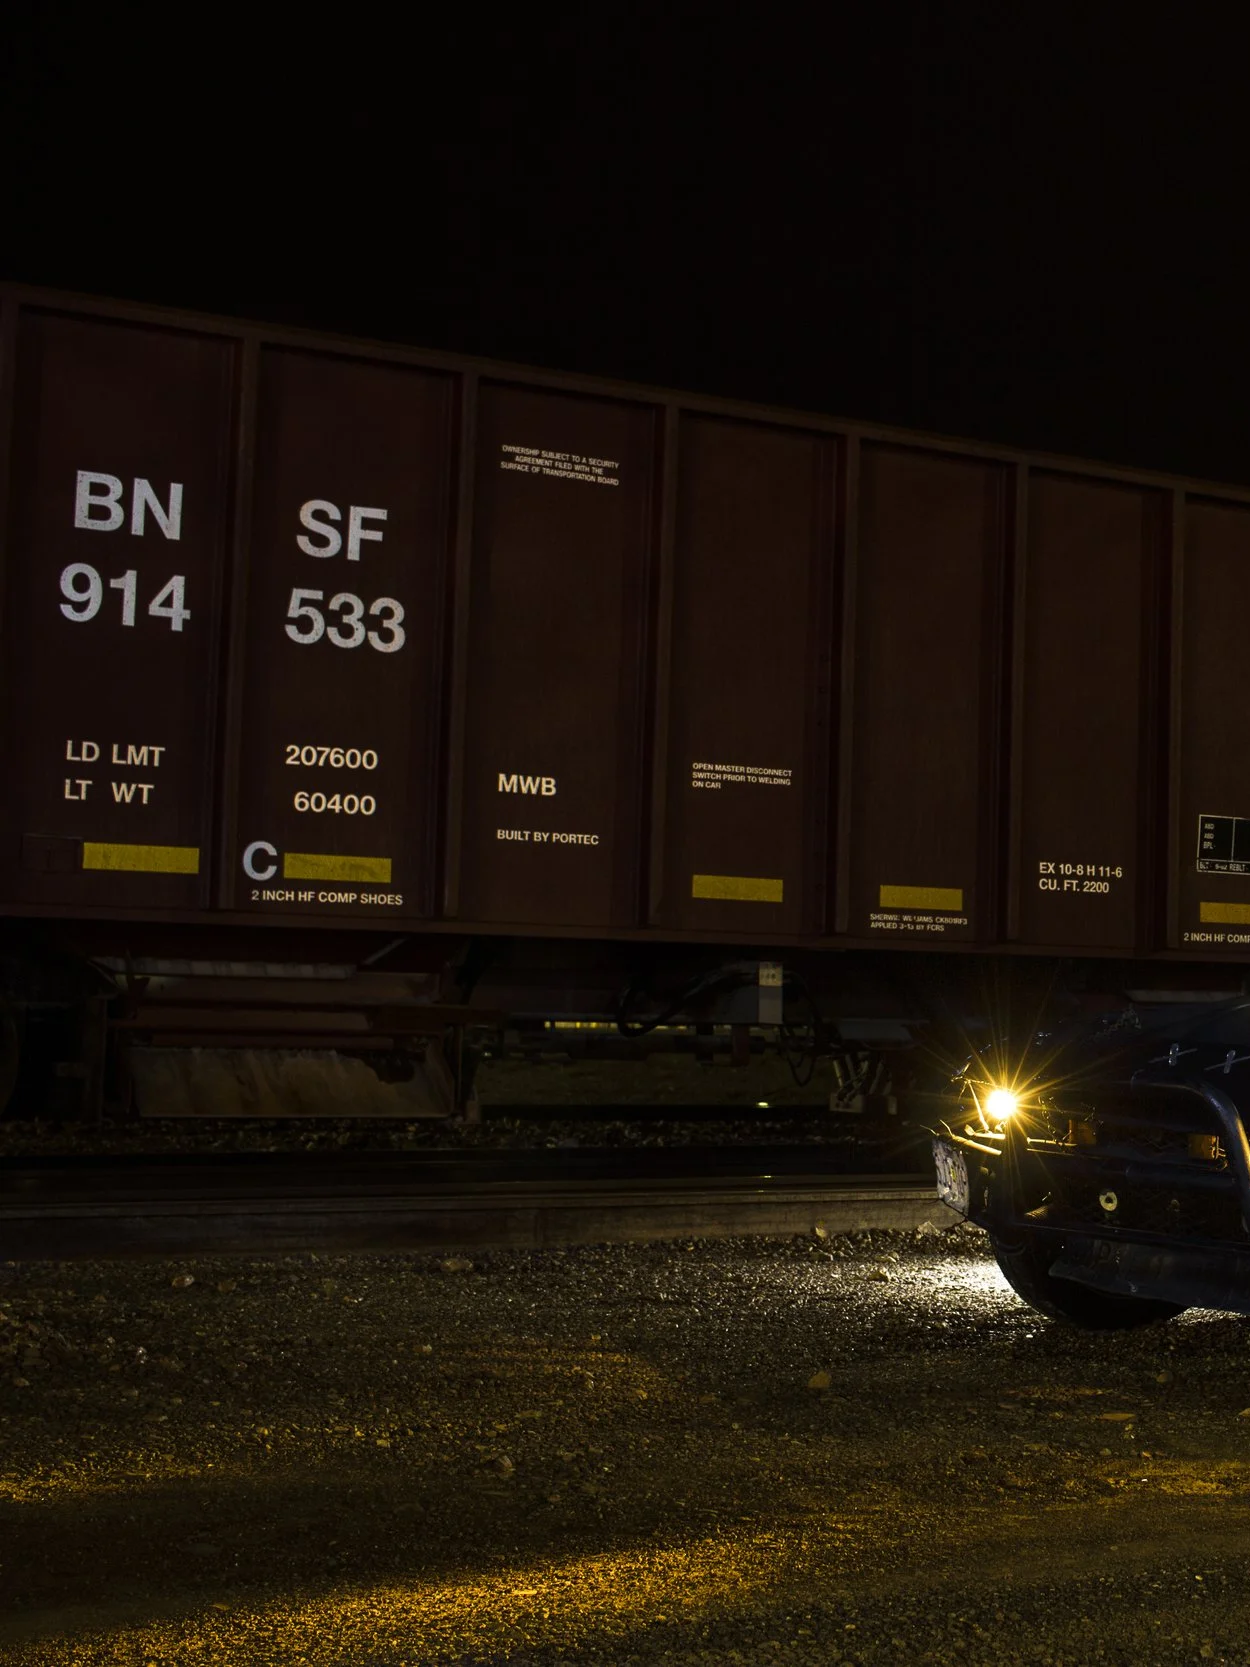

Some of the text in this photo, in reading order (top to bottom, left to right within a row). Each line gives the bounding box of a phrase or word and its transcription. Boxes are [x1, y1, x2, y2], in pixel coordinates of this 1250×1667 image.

[501, 444, 620, 469] OWNERSHIP SUBJECT TO A SECURITY
[515, 455, 604, 475] AGREEMENT FILED WITH THE
[500, 461, 620, 486] SURFACE OF TRANSPORTATION BOARD
[74, 469, 184, 541] BN
[296, 499, 389, 562] SF
[58, 562, 192, 632] 914
[284, 587, 407, 653] 533
[66, 739, 166, 767] LD LMT
[284, 744, 379, 771] 207600
[692, 762, 793, 777] OPEN MASTER DISCONNECT
[692, 771, 792, 786] SWITCH PRIOR TO WELDING
[64, 778, 155, 805] LT WT
[497, 772, 557, 796] MWB
[692, 780, 722, 790] ON CAR
[293, 791, 377, 816] 60400
[496, 828, 600, 846] BUILT BY PORTEC
[242, 840, 279, 882] C
[1039, 862, 1123, 878] EX 10-8 H 11-6
[251, 889, 404, 906] 2 INCH HF COMP SHOES
[1039, 878, 1109, 893] CU. FT. 2200
[1183, 932, 1190, 941] 2
[1190, 933, 1212, 942] INCH
[1214, 933, 1226, 943] HF
